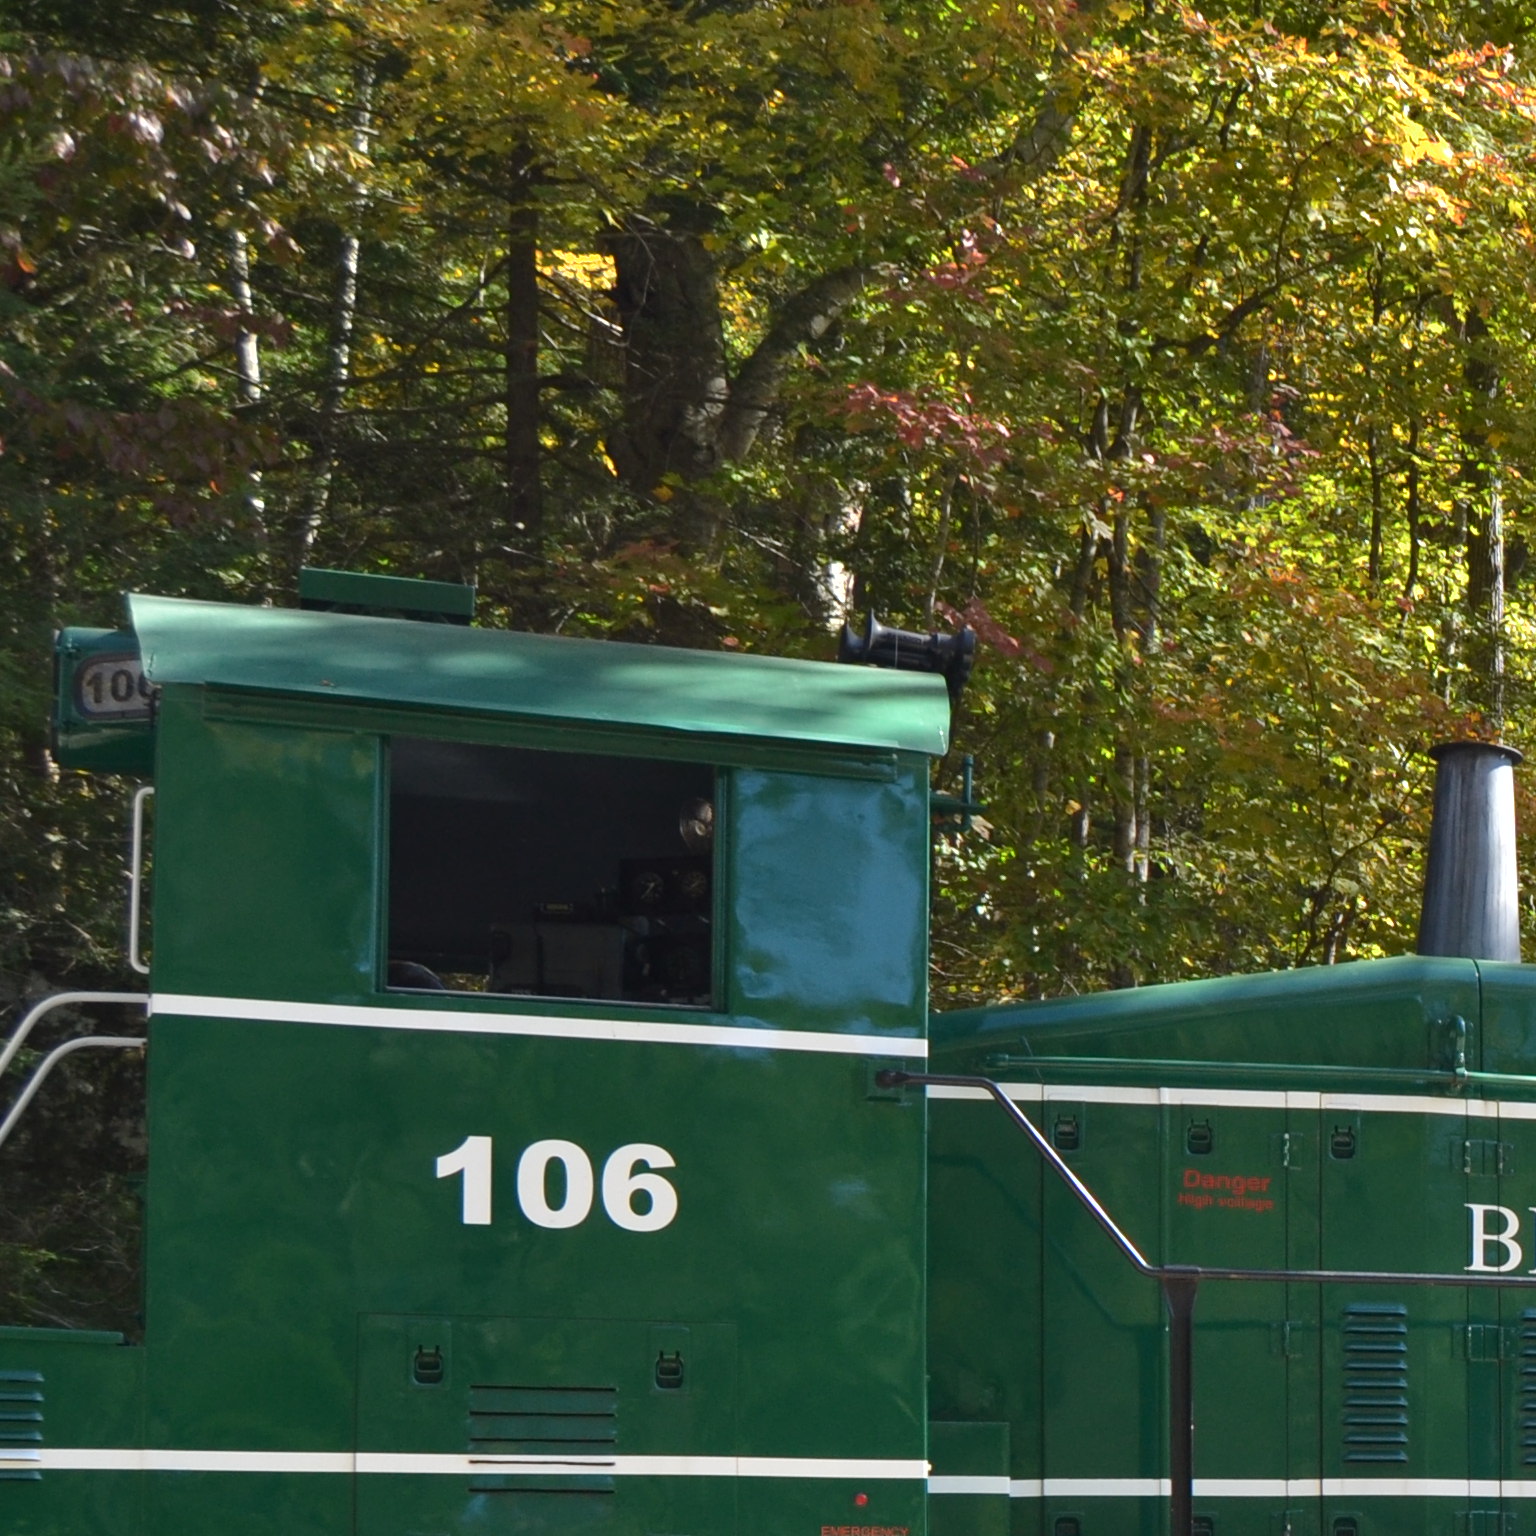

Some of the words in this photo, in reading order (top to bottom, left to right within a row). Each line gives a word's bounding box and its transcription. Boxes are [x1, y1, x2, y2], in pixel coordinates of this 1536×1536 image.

[436, 1135, 678, 1232] 106
[1183, 1169, 1271, 1195] Danger
[1177, 1193, 1214, 1210] High
